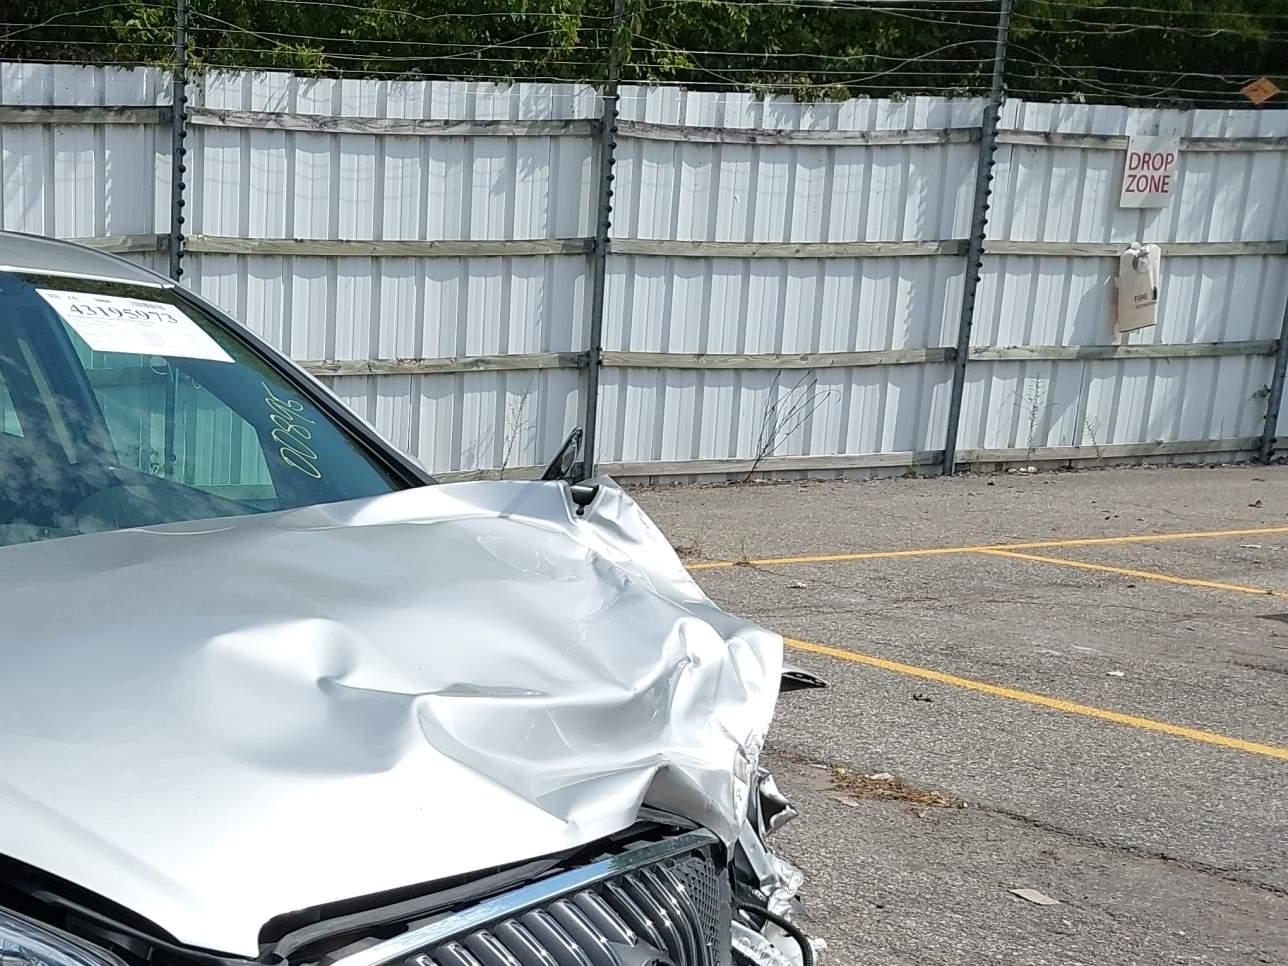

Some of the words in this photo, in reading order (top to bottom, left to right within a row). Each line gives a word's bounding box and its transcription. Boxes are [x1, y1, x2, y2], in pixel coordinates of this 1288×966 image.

[1128, 153, 1174, 171] DROP
[1125, 175, 1170, 193] ZONE
[69, 303, 179, 324] 43195973
